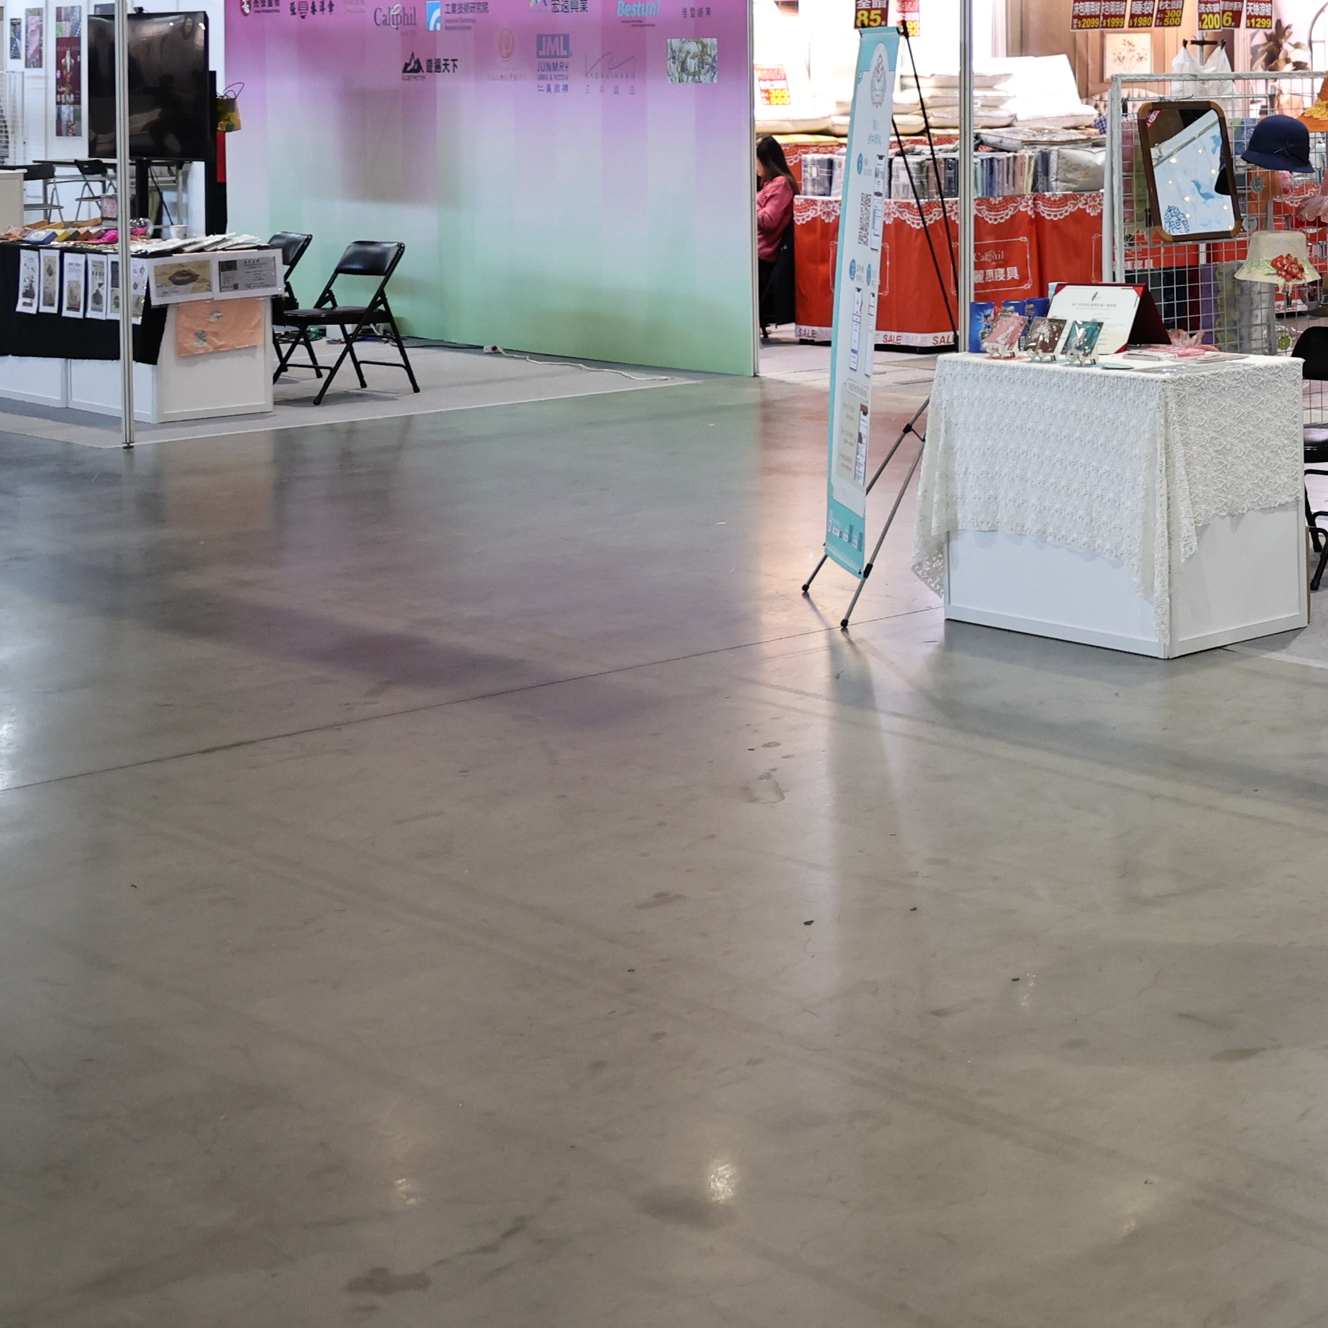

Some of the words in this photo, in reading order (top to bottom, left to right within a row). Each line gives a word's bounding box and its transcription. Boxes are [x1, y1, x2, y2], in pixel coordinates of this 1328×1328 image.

[373, 4, 417, 30] Caliphil
[797, 328, 817, 340] SALE
[882, 334, 902, 345] SALE
